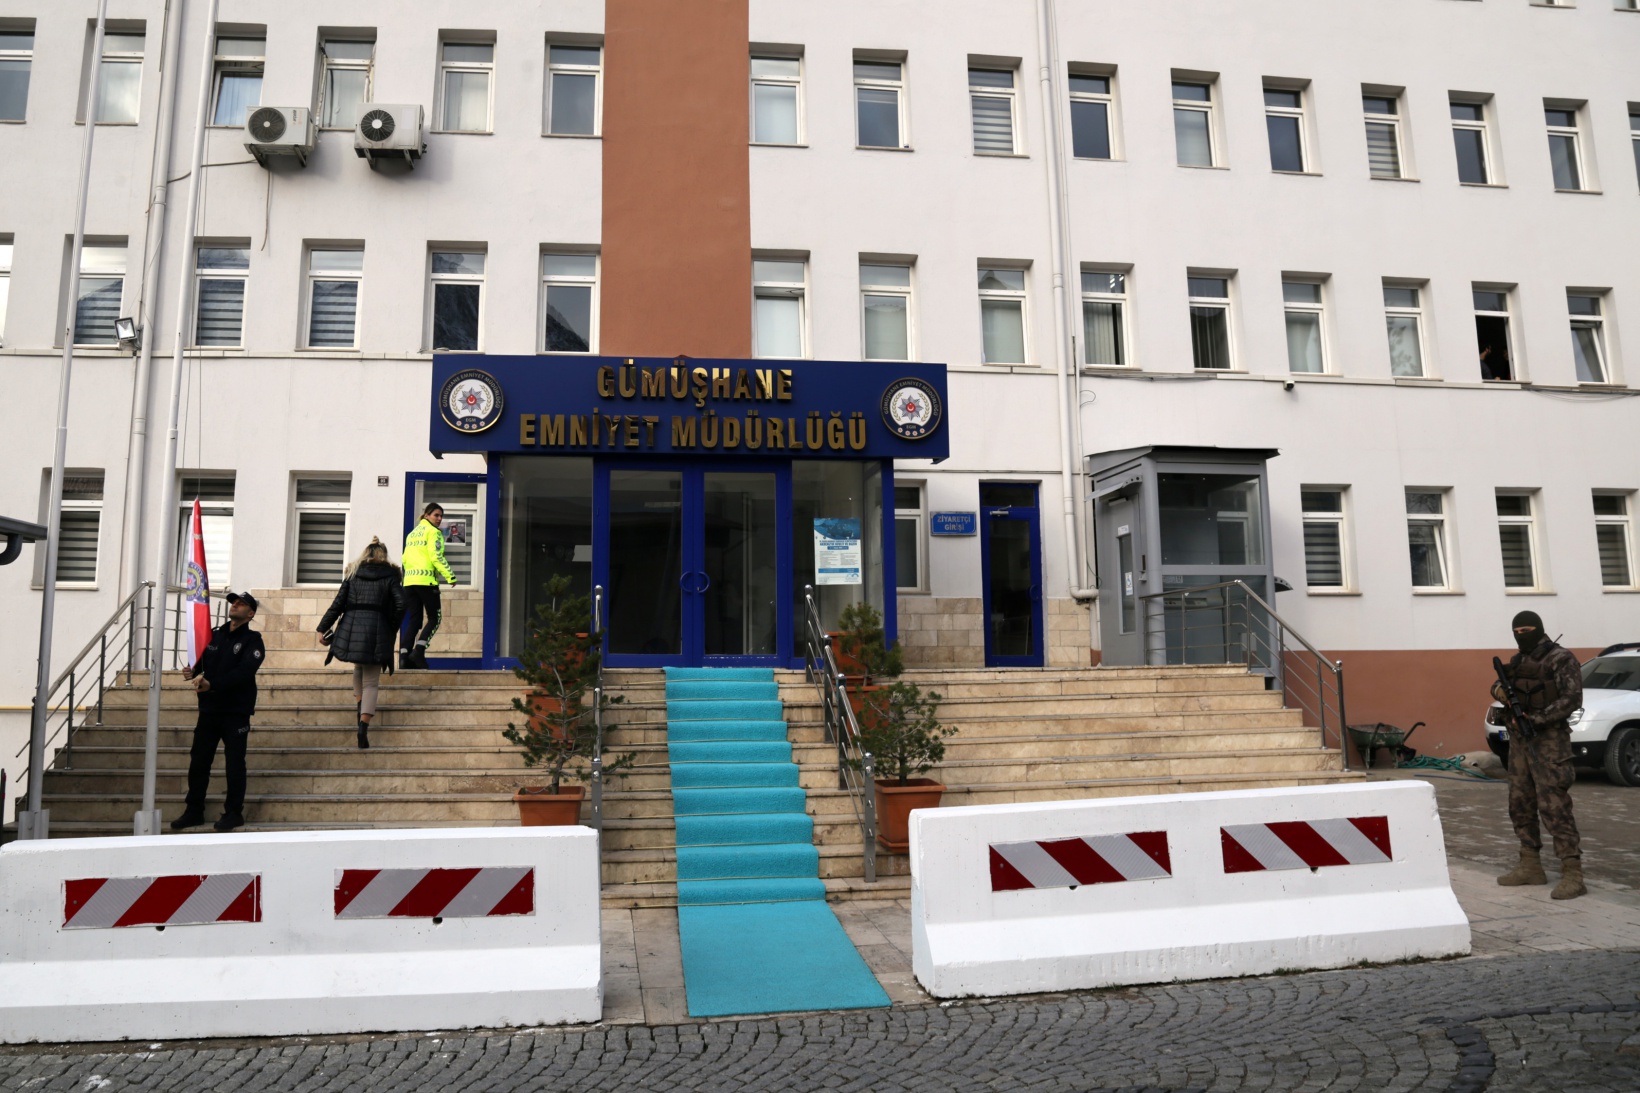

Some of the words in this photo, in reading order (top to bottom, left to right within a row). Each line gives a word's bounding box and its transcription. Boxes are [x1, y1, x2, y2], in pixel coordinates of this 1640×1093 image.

[597, 358, 792, 408] GÜMÜŞHANE
[519, 407, 659, 447] EMNİYET
[671, 409, 866, 450] MÜDÜRLÜĞÜ
[937, 514, 971, 524] ZİYARETÇİ
[944, 523, 965, 532] GİRİŞİ
